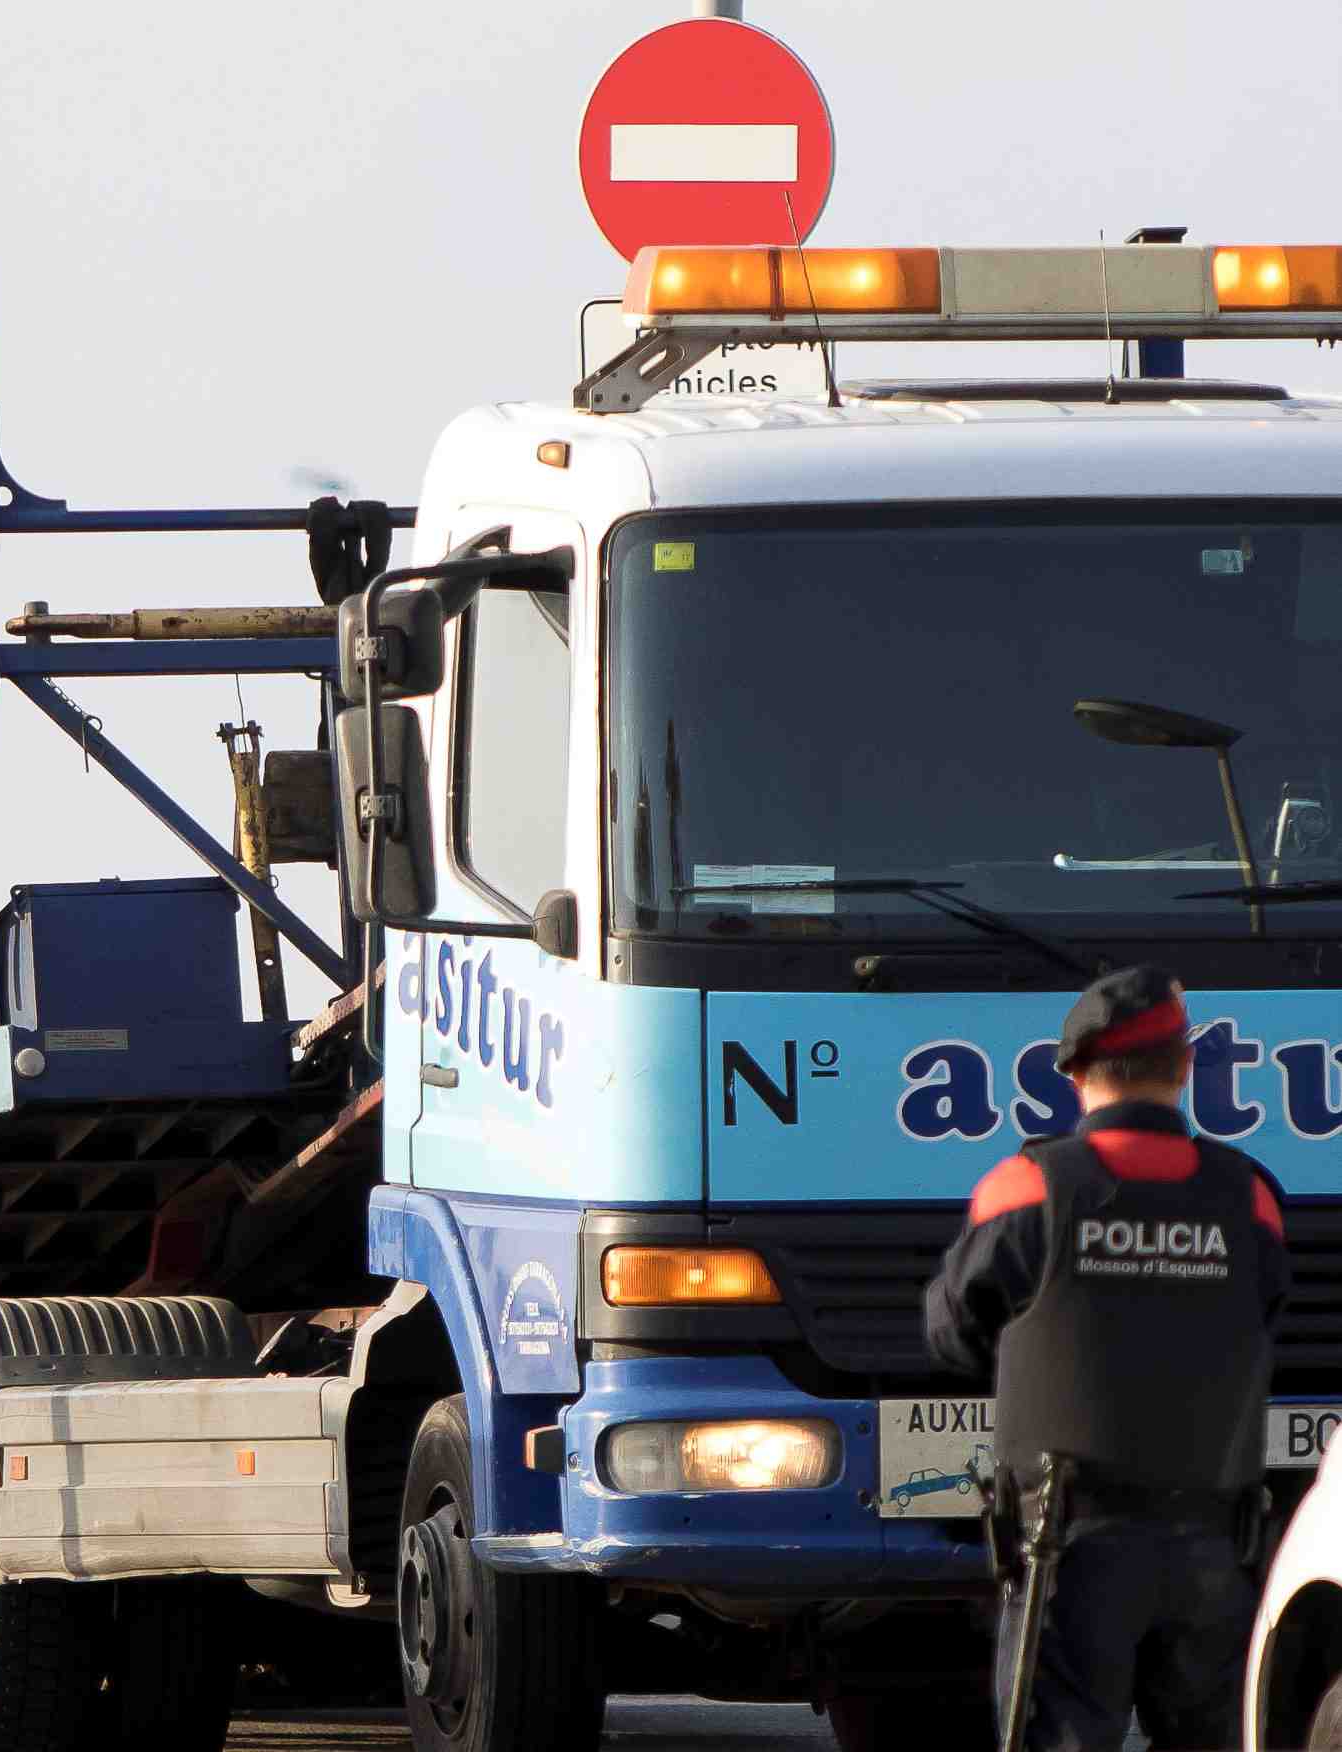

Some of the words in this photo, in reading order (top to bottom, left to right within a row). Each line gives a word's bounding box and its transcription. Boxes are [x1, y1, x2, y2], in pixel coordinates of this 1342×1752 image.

[398, 930, 564, 1108] asitur
[896, 1017, 1342, 1141] astu
[1079, 1220, 1229, 1257] POLICIA
[1078, 1257, 1140, 1273] Mossos
[908, 1402, 995, 1433] AUXIL
